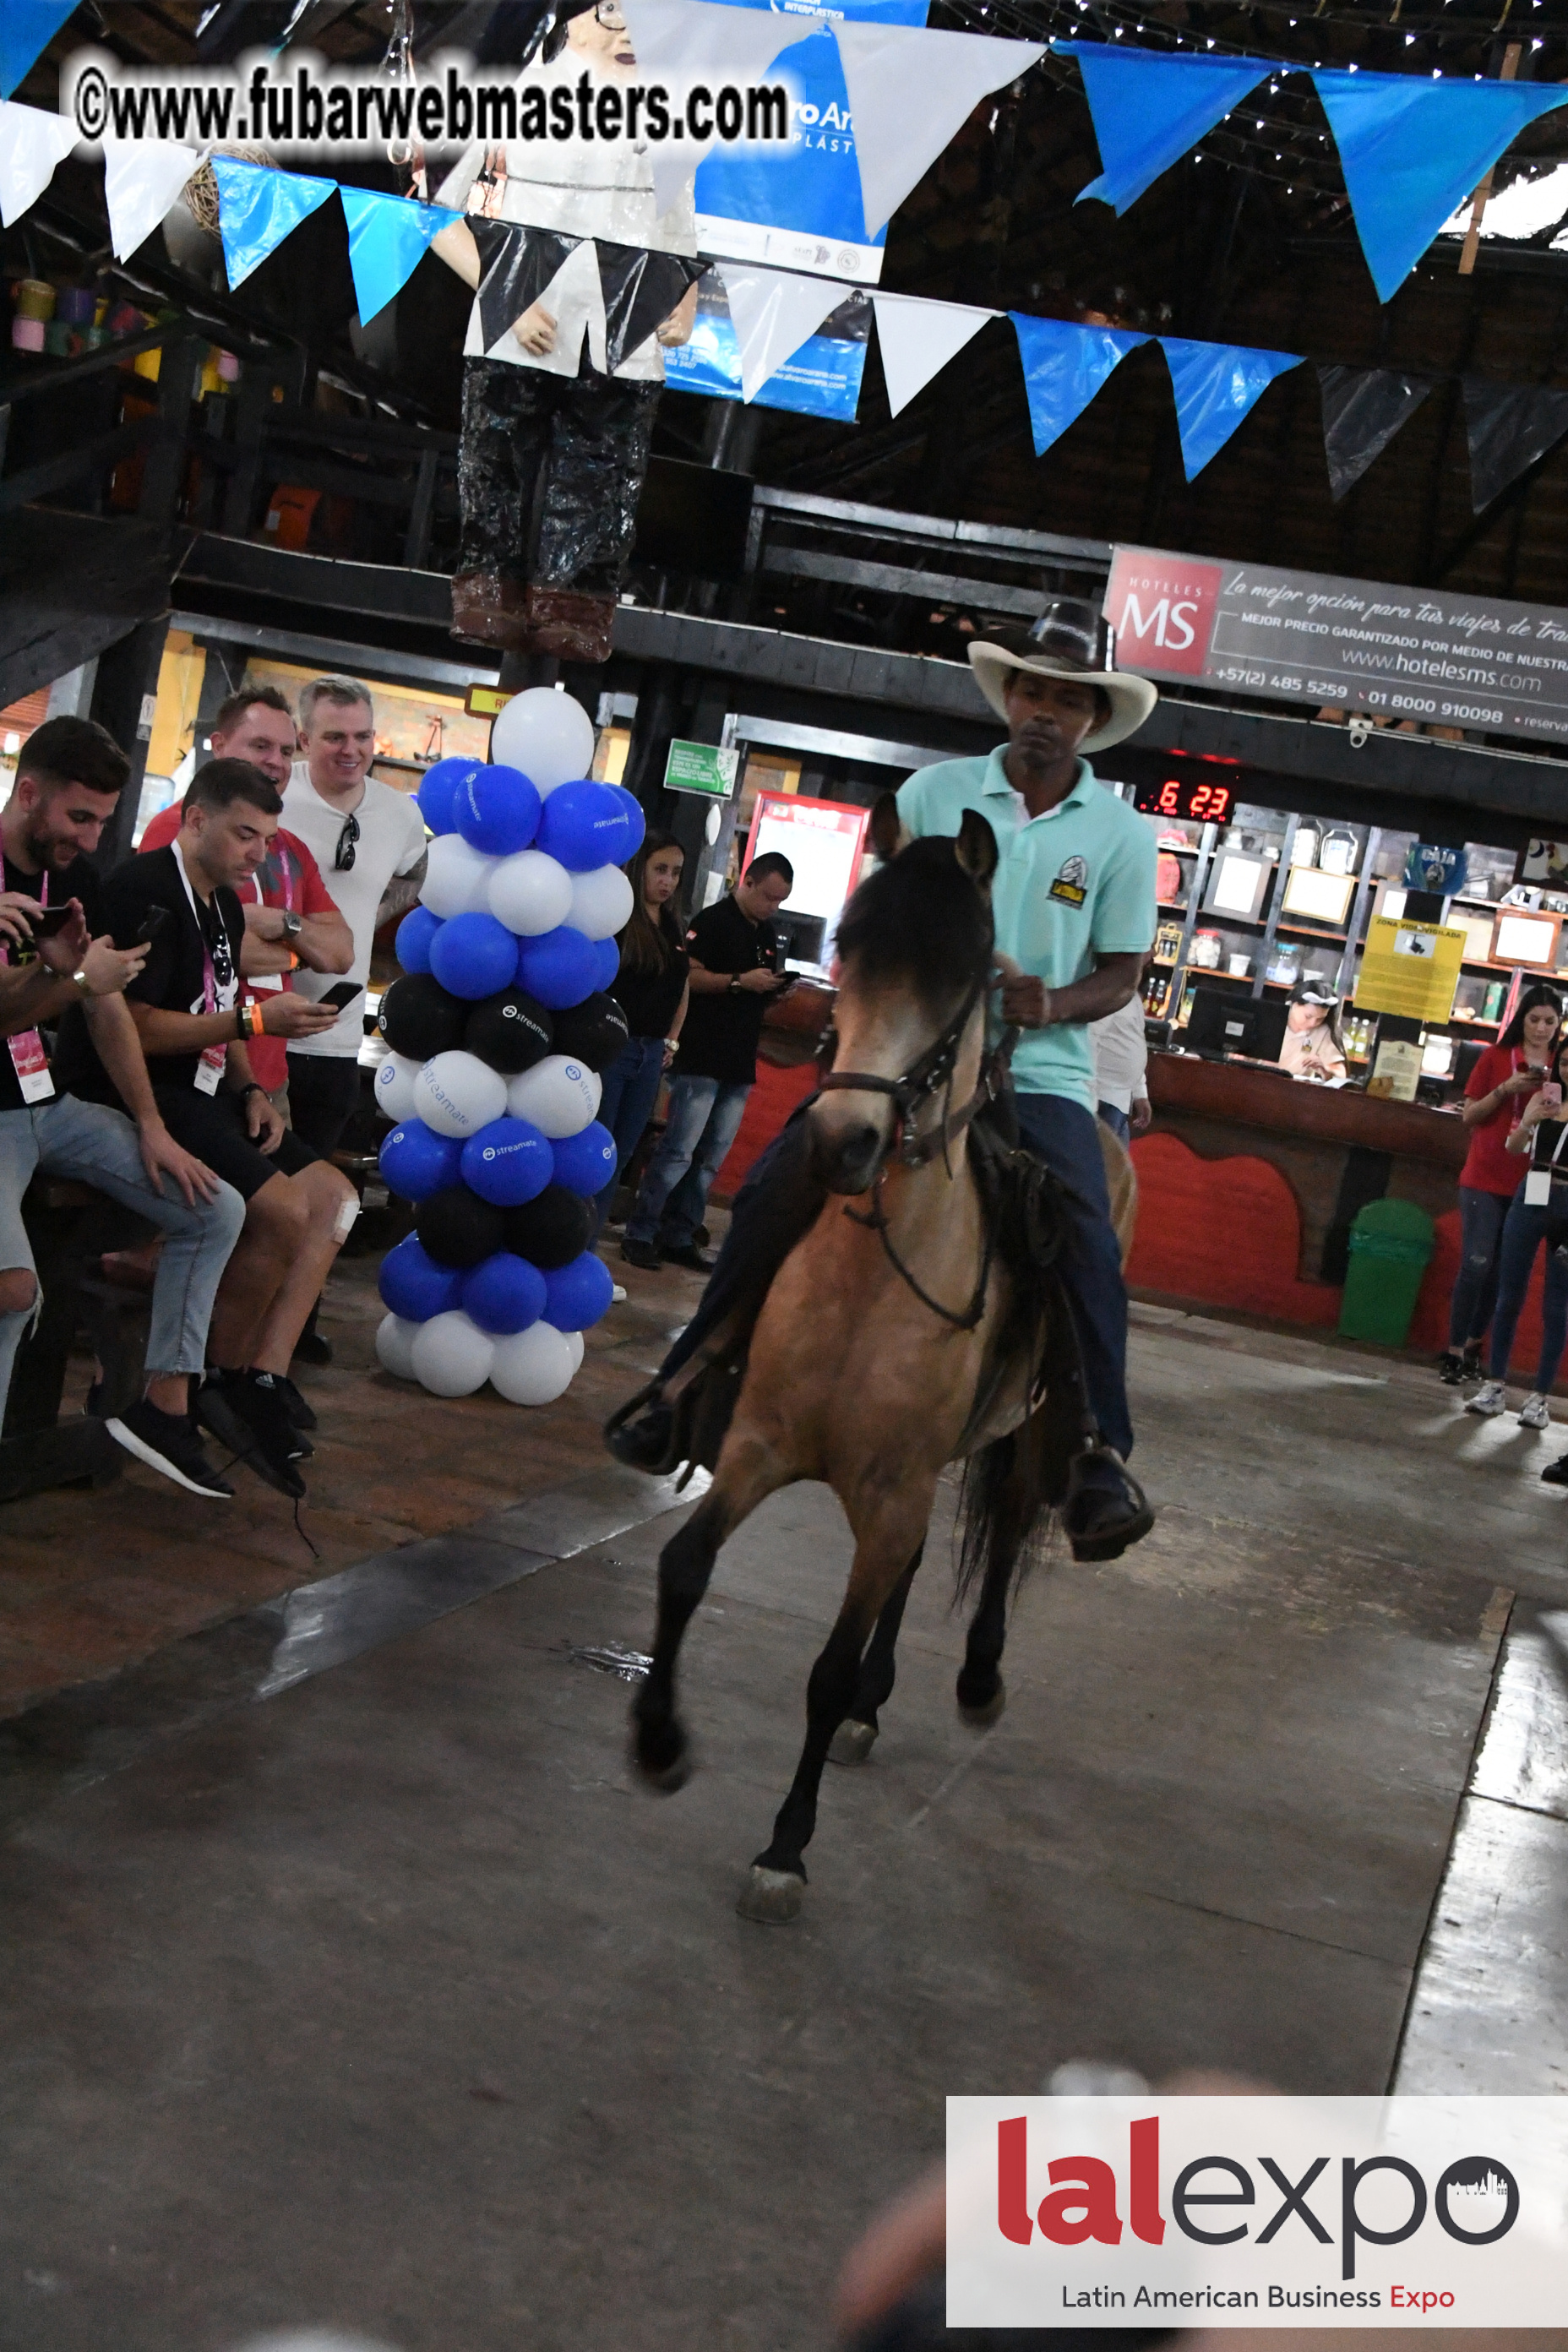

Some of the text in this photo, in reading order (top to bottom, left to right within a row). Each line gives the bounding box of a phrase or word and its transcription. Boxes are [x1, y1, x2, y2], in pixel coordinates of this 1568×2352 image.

[792, 132, 853, 154] PLÁST
[1129, 577, 1202, 597] HOTELES
[1224, 571, 1247, 596] La
[1250, 585, 1304, 608] mejor
[1306, 593, 1366, 614] opción
[1360, 602, 1412, 623] para
[1415, 602, 1444, 625] tus
[1448, 612, 1501, 638] viajes
[1506, 617, 1532, 637] de
[1116, 593, 1198, 651] MS
[1241, 612, 1281, 628] MEJOR
[1284, 618, 1330, 635] PRECIO
[1331, 626, 1419, 650] GARANTIZADO
[1422, 639, 1449, 654] POR
[1451, 644, 1494, 660] MEDIO
[1496, 651, 1514, 663] DE
[1217, 667, 1348, 699] +57(2) 485 5259
[1342, 649, 1543, 693] www.hotelesms.com
[1368, 690, 1503, 724] 01 8000 910098
[1524, 716, 1568, 732] reserva
[1159, 781, 1180, 808] 6
[1190, 784, 1229, 815] 23
[515, 1012, 550, 1043] streamate
[422, 1069, 470, 1126] streamate
[496, 1140, 537, 1156] streamate
